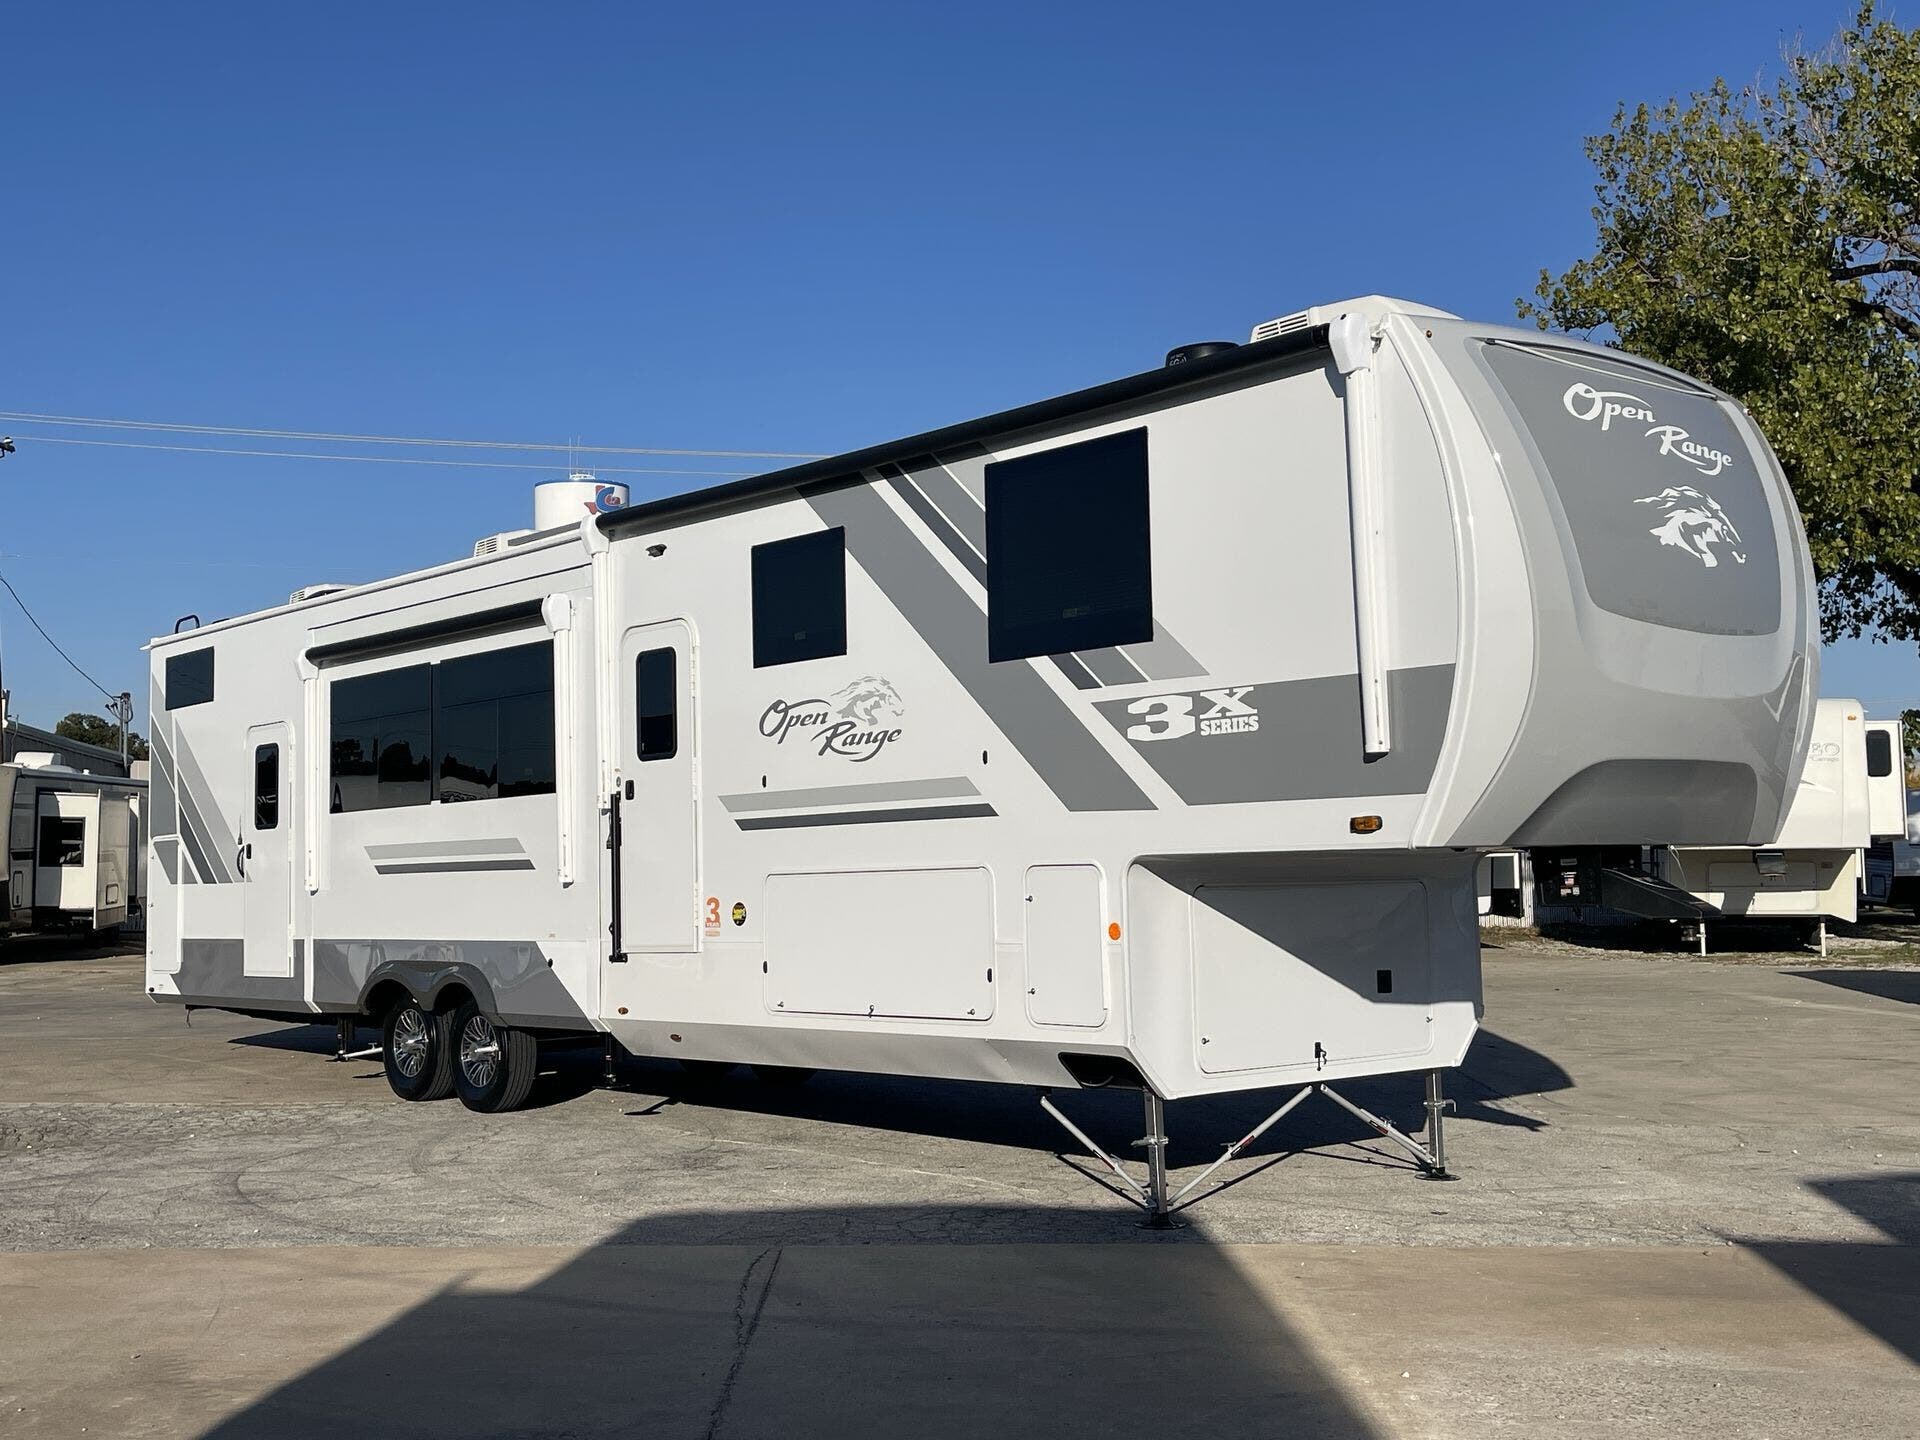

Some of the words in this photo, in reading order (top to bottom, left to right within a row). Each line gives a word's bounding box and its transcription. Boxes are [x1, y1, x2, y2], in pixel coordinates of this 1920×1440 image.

[1563, 382, 1656, 431] Open
[1644, 425, 1733, 476] Range
[759, 699, 832, 744] Open
[810, 720, 902, 762] Range
[1200, 715, 1259, 736] SERIES
[706, 896, 720, 923] 3
